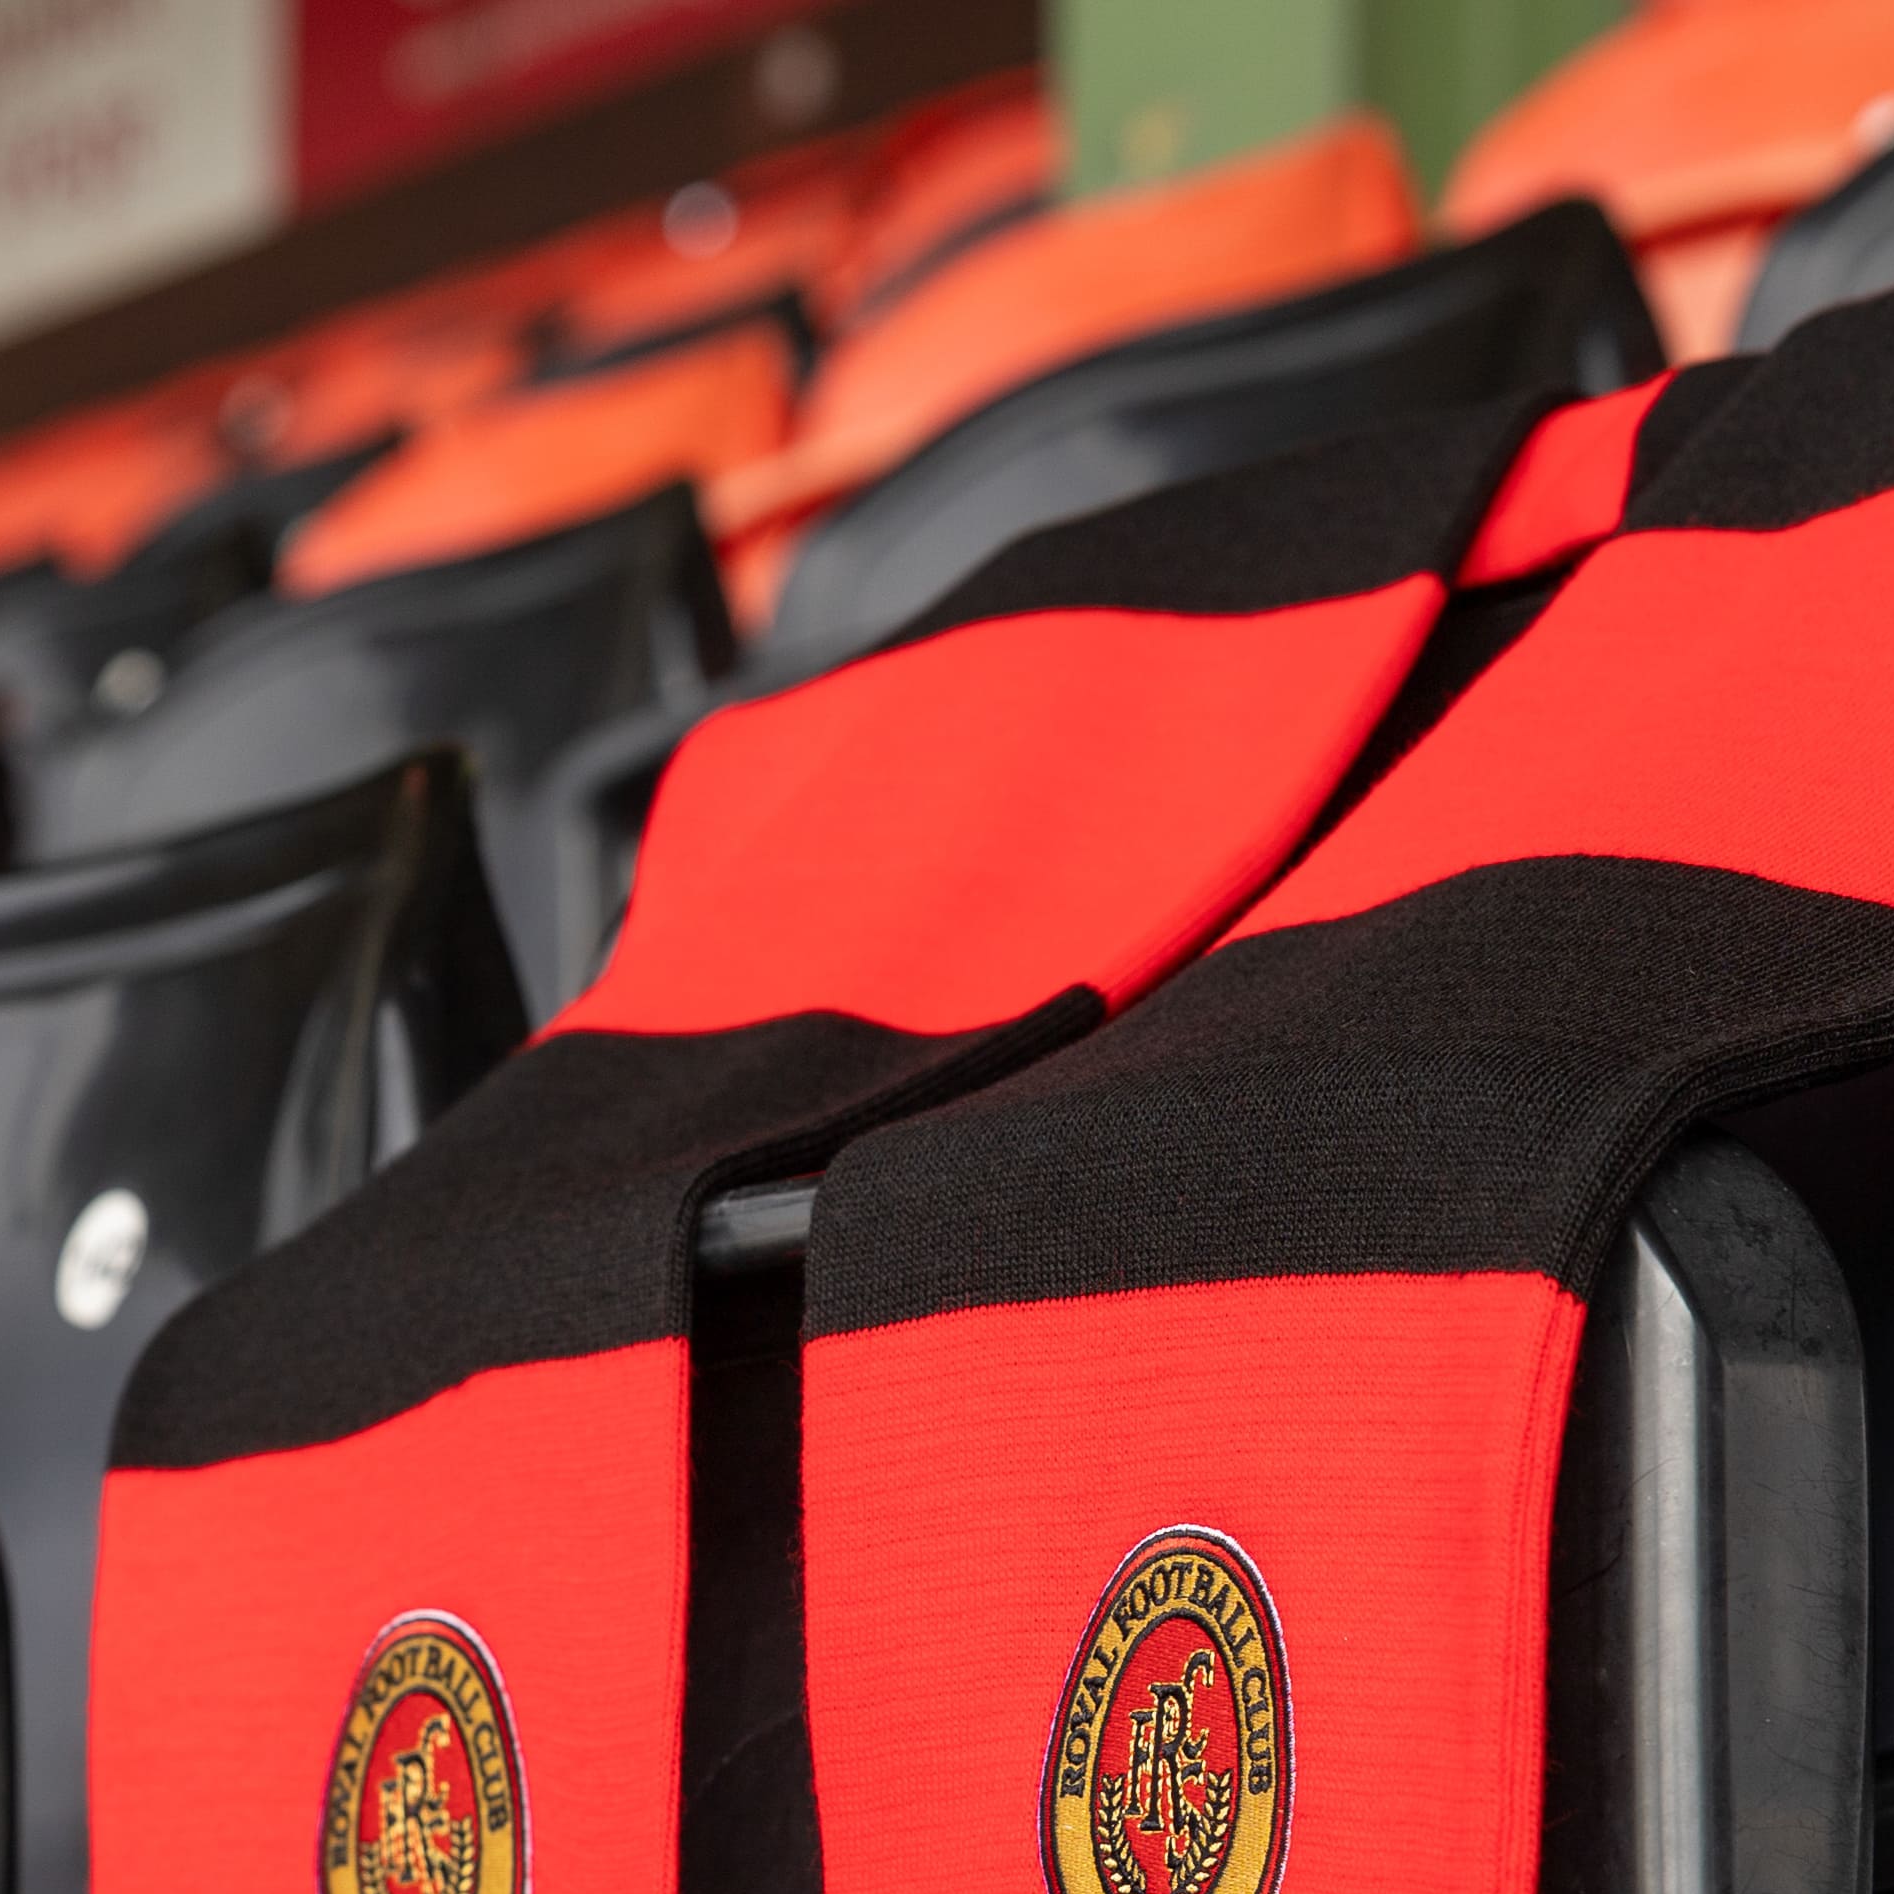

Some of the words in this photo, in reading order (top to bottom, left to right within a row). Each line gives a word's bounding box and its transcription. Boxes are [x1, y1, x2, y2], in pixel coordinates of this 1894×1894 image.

[359, 1644, 475, 1725] FOOTBALL
[473, 1722, 508, 1833] CLUB
[1061, 1647, 1120, 1799] ROYAL
[1117, 1562, 1255, 1664] FOOTBALL
[1240, 1669, 1272, 1796] CLUB
